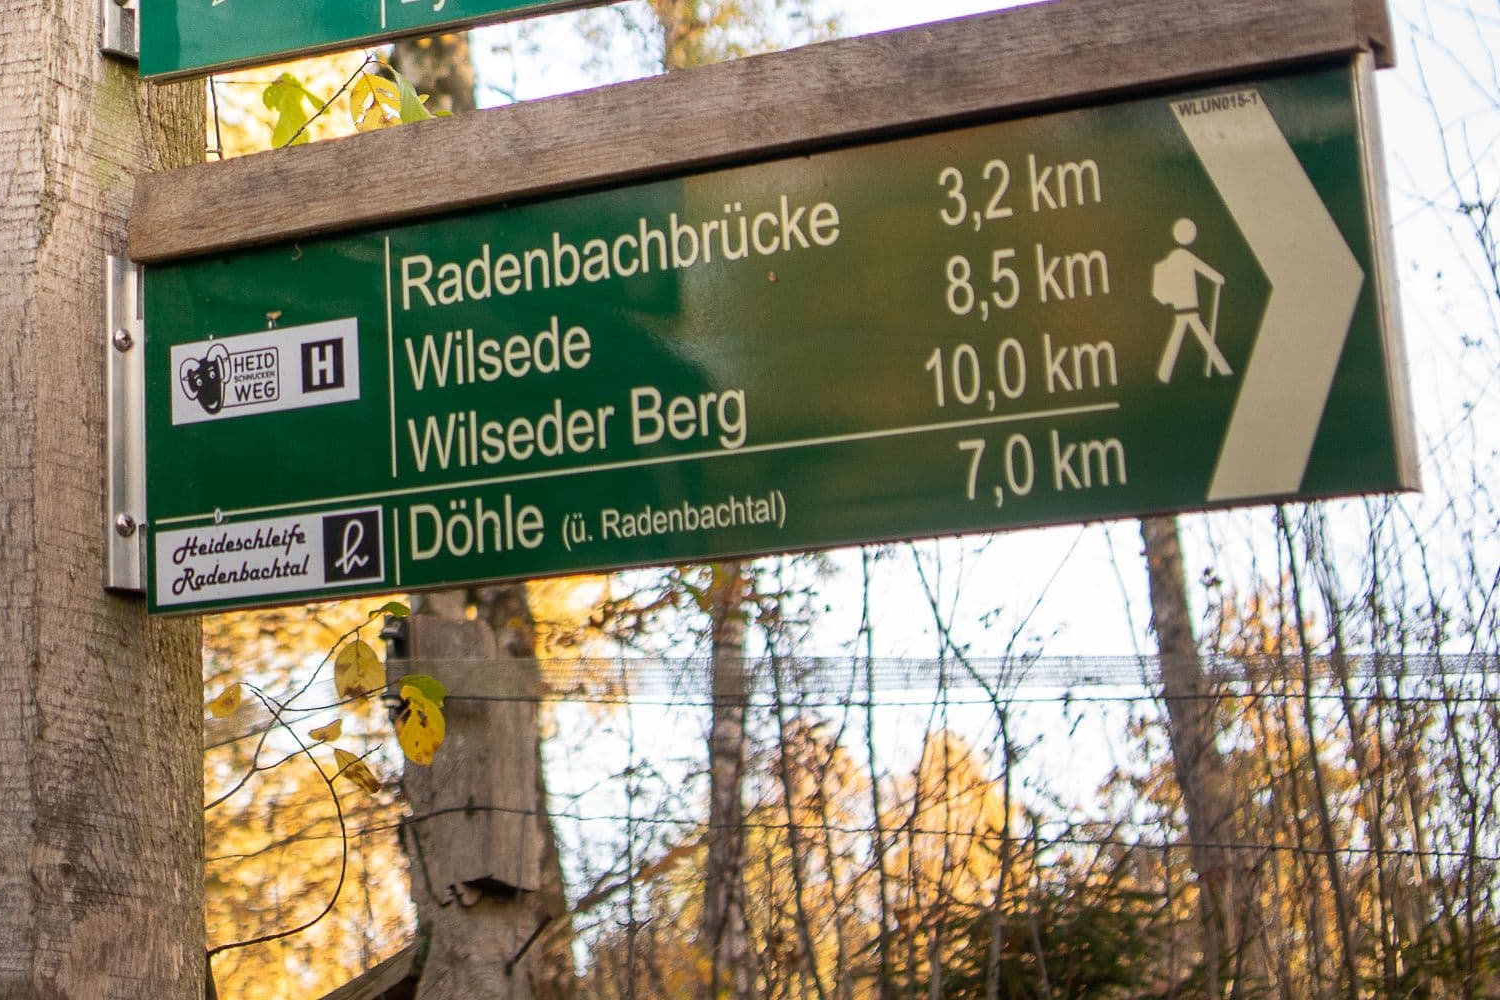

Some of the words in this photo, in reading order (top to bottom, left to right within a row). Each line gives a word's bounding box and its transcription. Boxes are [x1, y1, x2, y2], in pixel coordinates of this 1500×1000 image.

[1178, 91, 1258, 117] WLUN015-1
[401, 196, 840, 310] Radenbachbrücke
[938, 159, 1013, 231] 3,2
[1028, 154, 1101, 212] km
[405, 316, 591, 391] Wilsede
[946, 248, 1020, 322] 8,5
[1036, 243, 1110, 303] km
[233, 352, 275, 373] HEID
[233, 370, 276, 384] SCHNUCKEN
[311, 344, 334, 386] H
[234, 379, 276, 402] WEG
[407, 399, 614, 473] Wilseder
[631, 386, 748, 450] Berg
[924, 337, 1026, 410] 10,0
[1043, 333, 1118, 393] km
[410, 494, 544, 561] Döhle
[561, 516, 594, 552] (ü.
[601, 491, 787, 541] Radenbachtal)
[958, 433, 1033, 508] 7,0
[1051, 429, 1126, 491] km
[172, 524, 306, 564] Heideschleife
[172, 554, 310, 595] Radenbachtal
